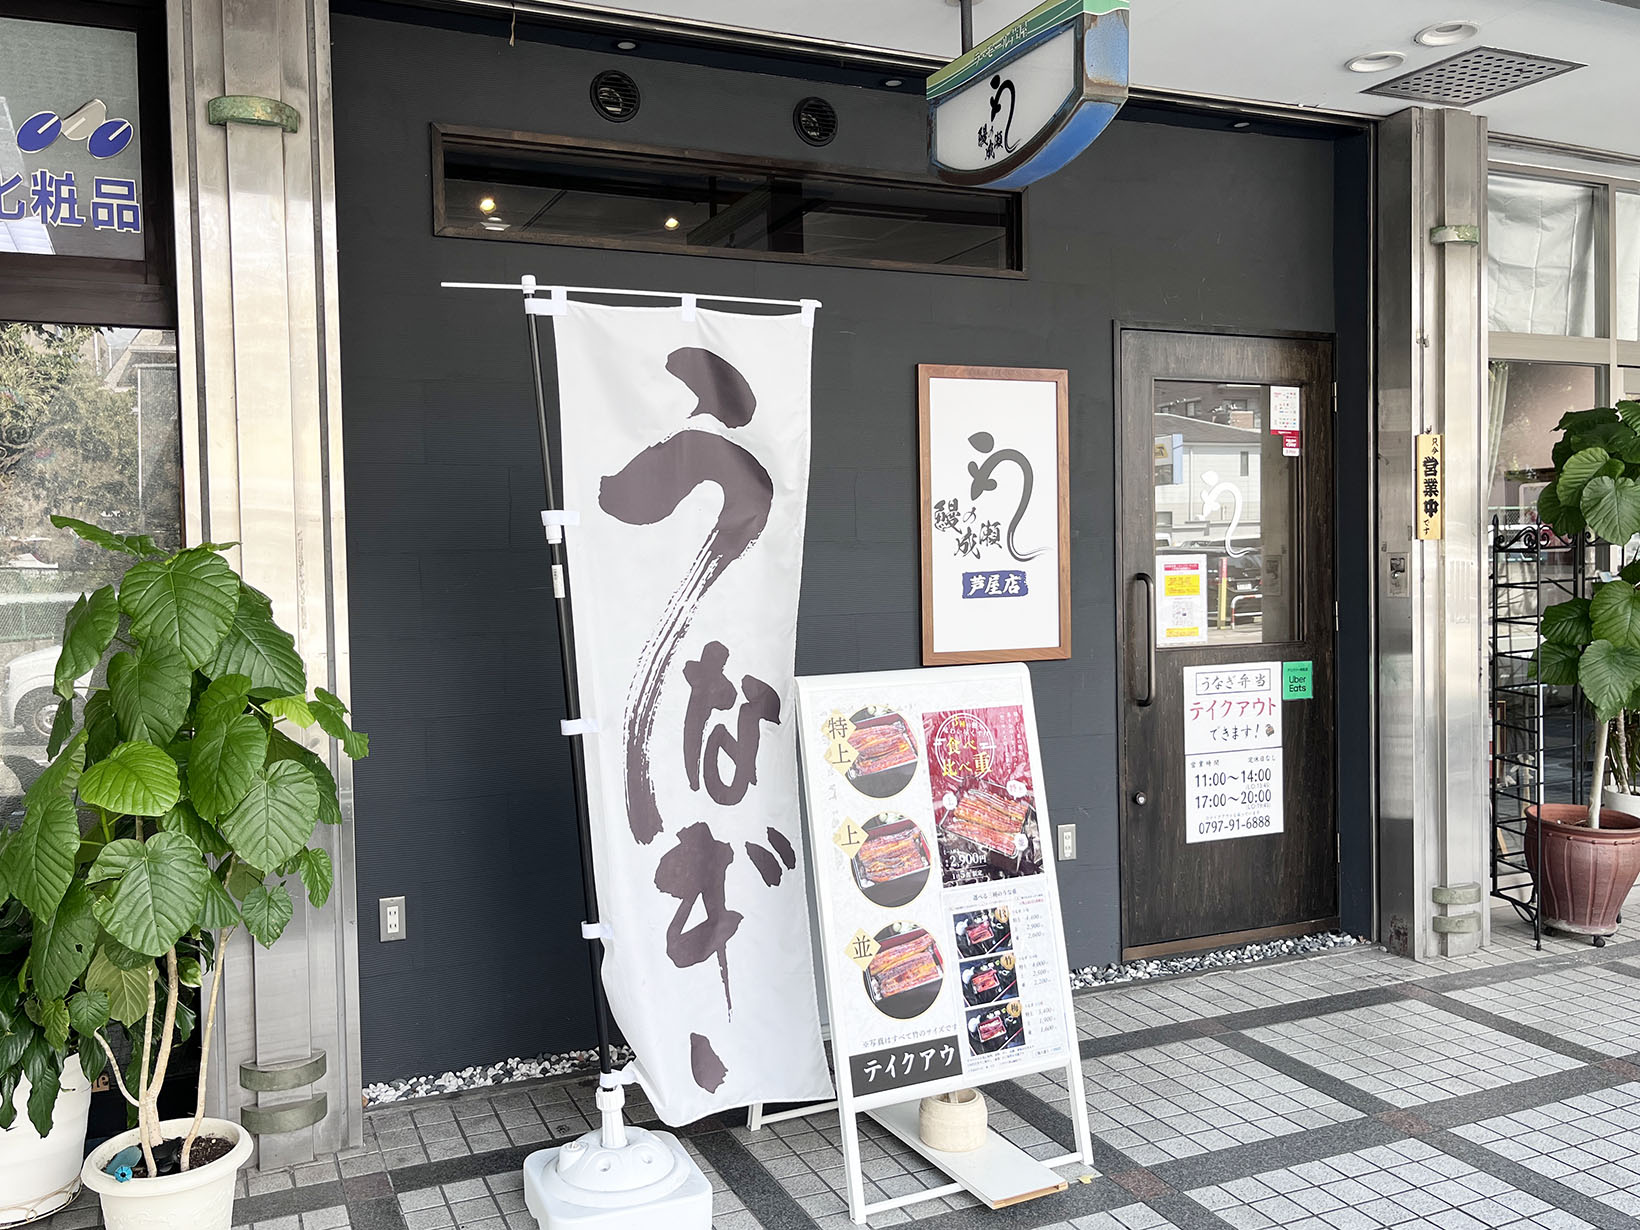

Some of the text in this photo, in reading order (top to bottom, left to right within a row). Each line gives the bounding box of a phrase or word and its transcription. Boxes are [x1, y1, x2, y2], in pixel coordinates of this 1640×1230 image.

[967, 573, 1022, 596] 芦屋店
[1201, 673, 1267, 692] うなぎ弁当
[1289, 675, 1306, 684] Uber
[1289, 684, 1307, 693] Eats
[1189, 697, 1277, 721] テイクアウト
[828, 716, 852, 765] 特上
[841, 824, 861, 847] 上
[1198, 815, 1271, 835] 0797-91-6888
[852, 935, 873, 960] 並
